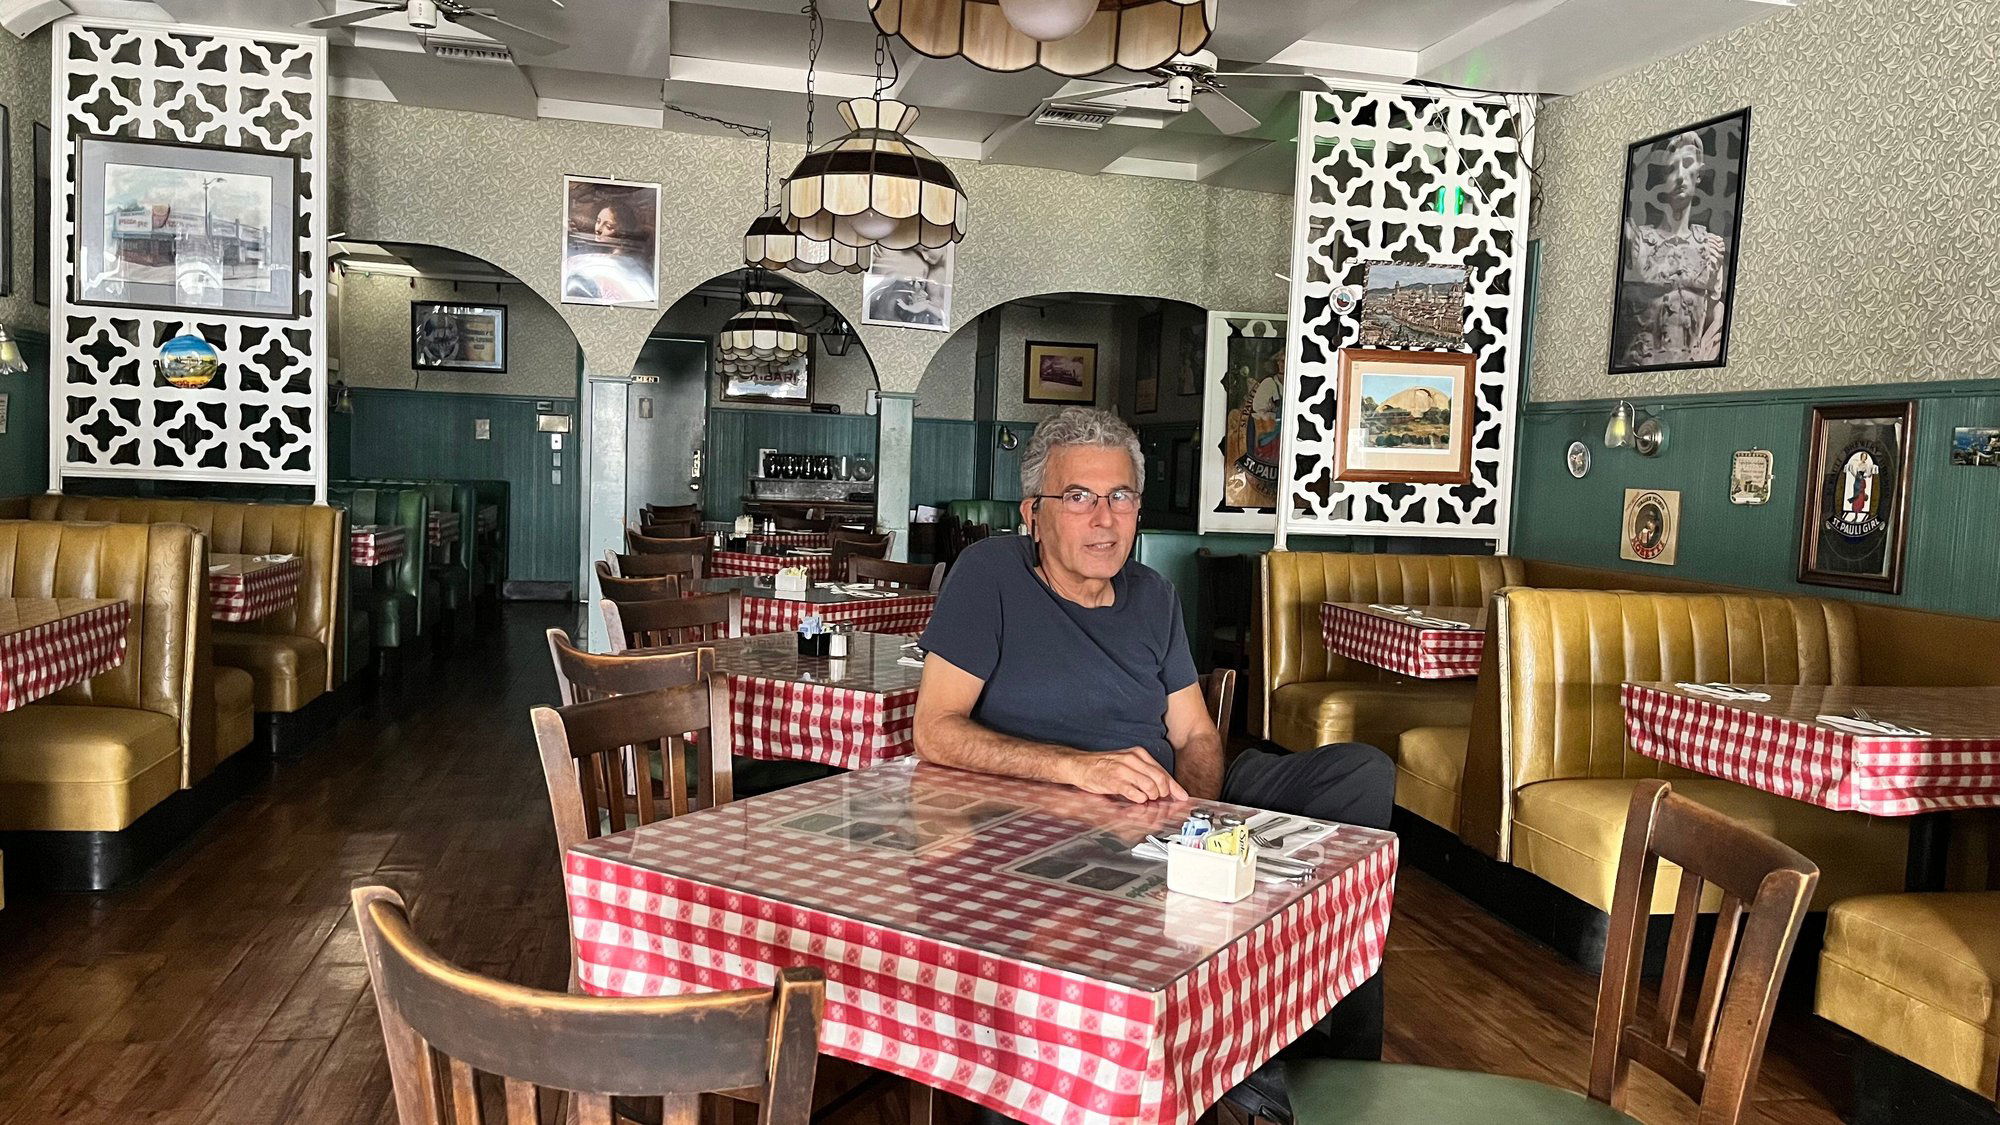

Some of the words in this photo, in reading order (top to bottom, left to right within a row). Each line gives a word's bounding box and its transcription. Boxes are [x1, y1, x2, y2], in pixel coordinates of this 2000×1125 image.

[1244, 457, 1256, 472] ST.
[1255, 464, 1278, 480] PAU
[1832, 517, 1841, 529] ST.
[1840, 522, 1861, 535] PAULI
[1862, 518, 1880, 533] GIRL
